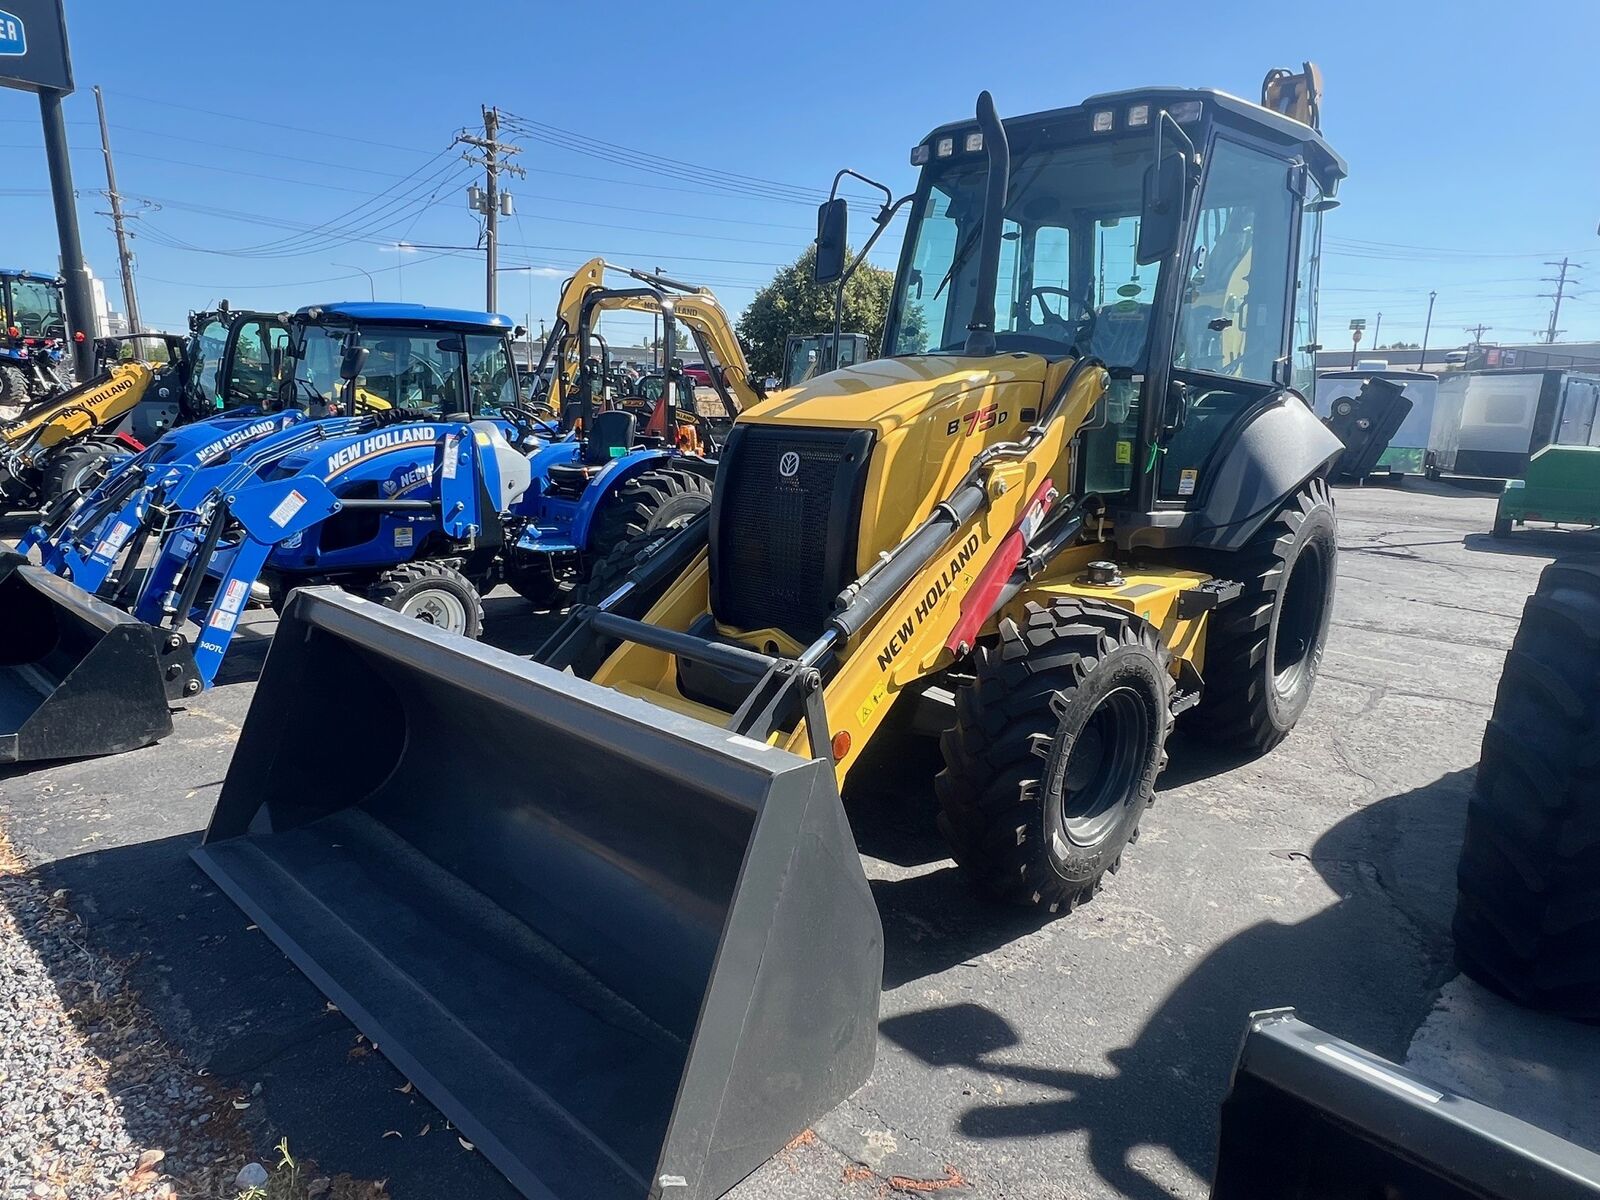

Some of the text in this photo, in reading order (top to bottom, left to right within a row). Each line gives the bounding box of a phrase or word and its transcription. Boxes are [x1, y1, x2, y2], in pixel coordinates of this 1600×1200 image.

[86, 379, 133, 407] HOLLAND
[195, 442, 223, 461] NEW
[222, 420, 275, 448] HOLLAND
[328, 427, 435, 473] NEW HOLLAND
[877, 534, 979, 672] NEW HOLLAND
